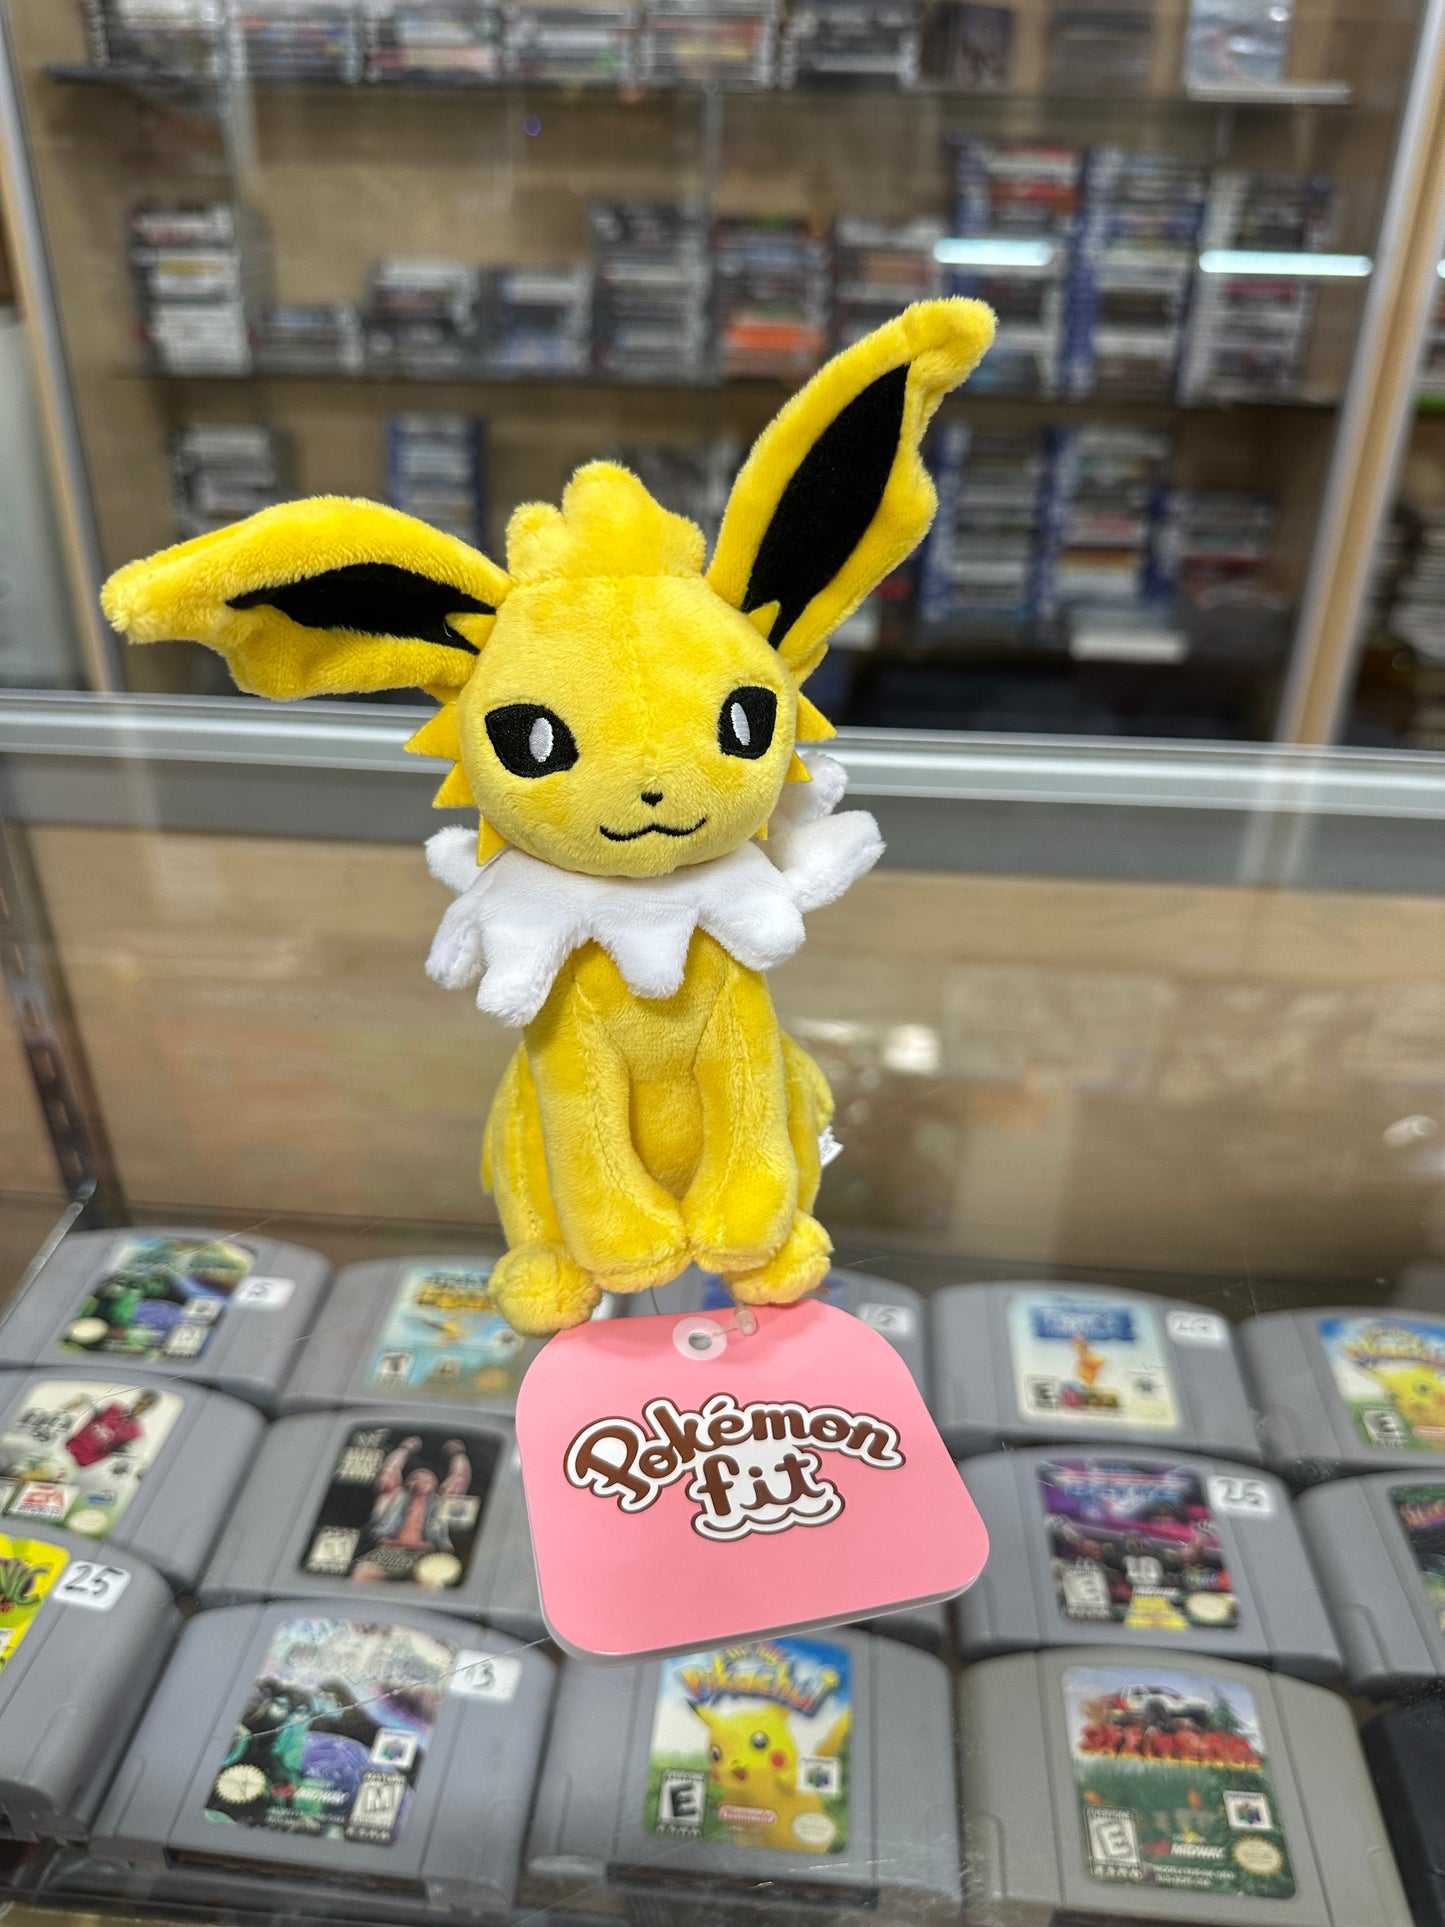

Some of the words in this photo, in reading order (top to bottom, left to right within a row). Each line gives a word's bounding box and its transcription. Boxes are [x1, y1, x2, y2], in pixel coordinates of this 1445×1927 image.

[572, 1400, 896, 1505] Pokémon
[696, 1452, 826, 1517] fit
[64, 1563, 124, 1596] 25
[670, 1783, 697, 1817] E
[1099, 1823, 1130, 1856] E
